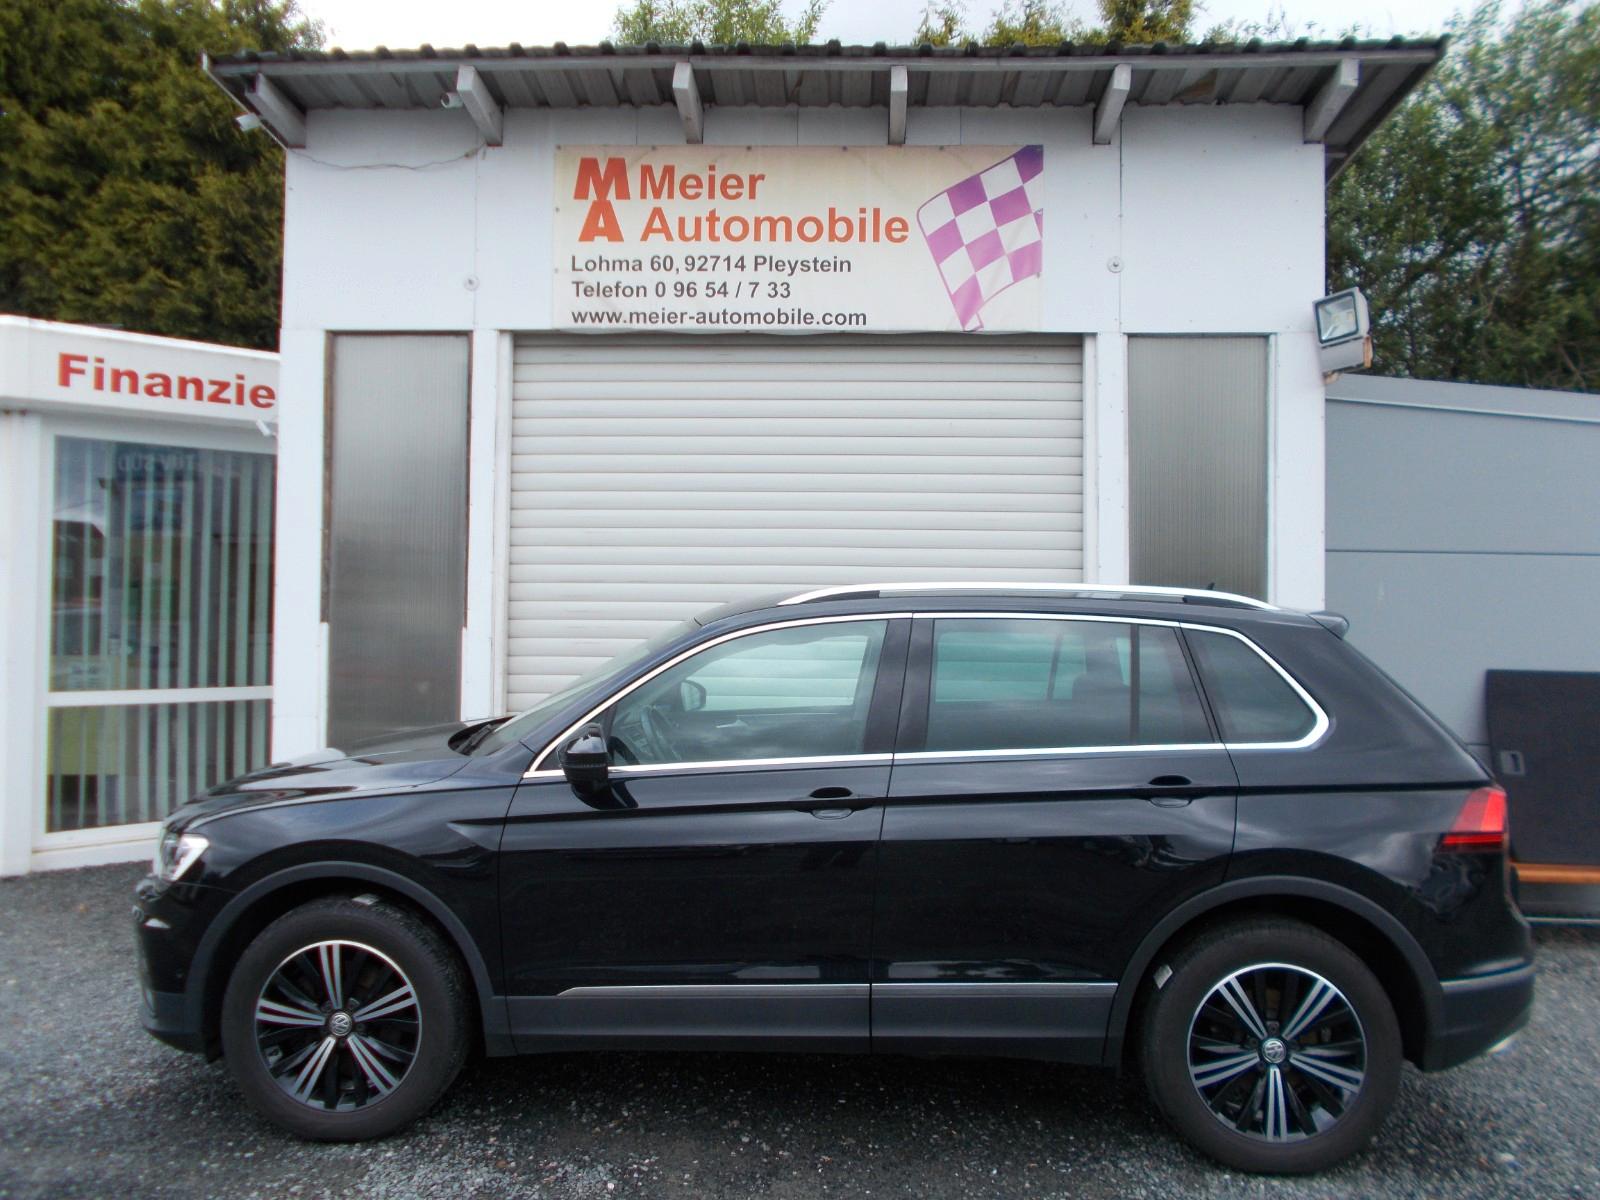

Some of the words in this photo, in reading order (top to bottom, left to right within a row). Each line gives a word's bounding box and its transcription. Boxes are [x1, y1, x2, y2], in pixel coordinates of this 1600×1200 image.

[639, 164, 766, 200] Meier
[640, 207, 909, 244] Automobile
[571, 255, 643, 273] Lohma
[754, 255, 852, 277] Pleystein
[572, 281, 648, 299] Telefon
[767, 281, 792, 299] 33
[571, 307, 868, 327] www.meier-automobile.com
[58, 352, 276, 409] Finanzie
